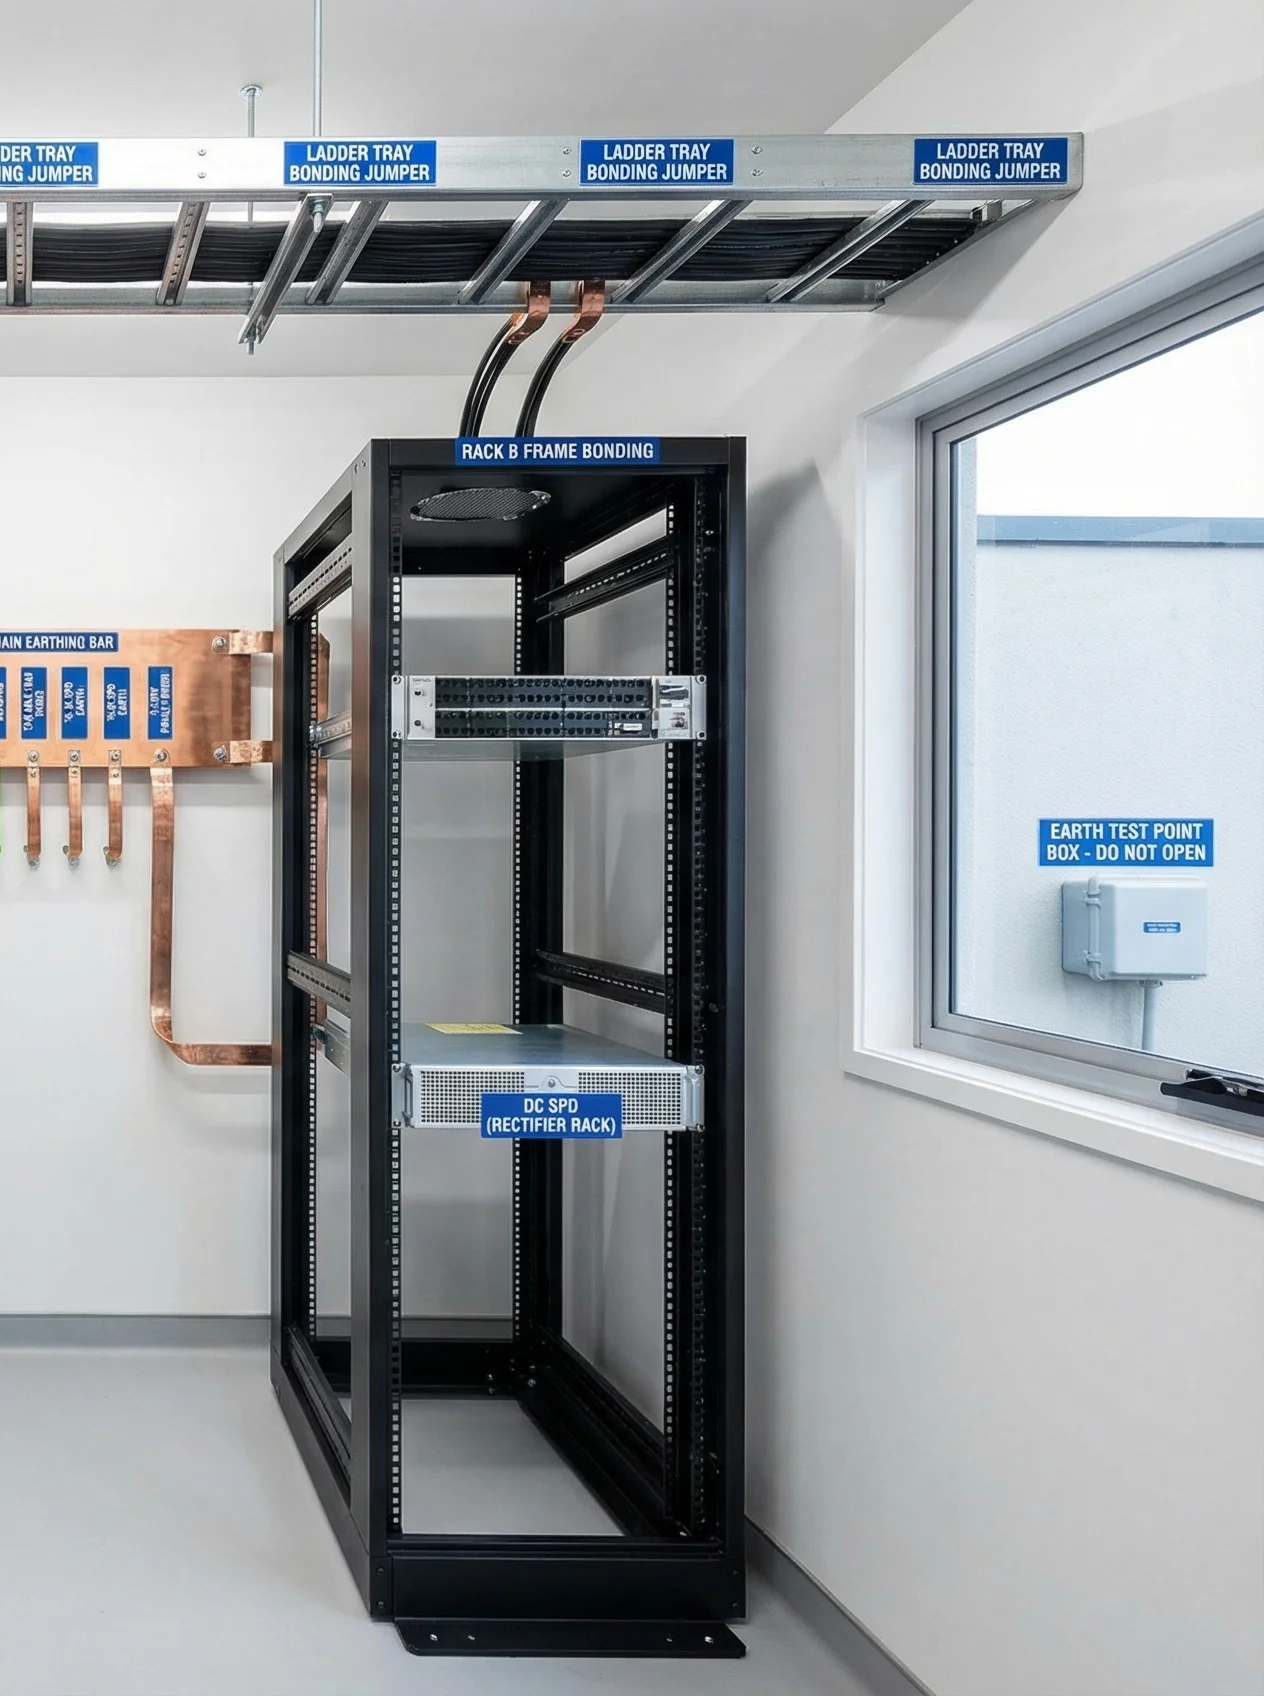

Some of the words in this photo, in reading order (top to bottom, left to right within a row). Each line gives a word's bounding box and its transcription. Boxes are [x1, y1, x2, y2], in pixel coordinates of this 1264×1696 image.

[35, 144, 77, 163] TRAY
[306, 144, 369, 162] LADDER
[372, 144, 414, 162] TRAY
[603, 143, 666, 161] LADDER
[669, 143, 711, 161] TRAY
[937, 142, 999, 160] LADDER
[1003, 142, 1044, 160] TRAY
[27, 164, 93, 183] JUMPER
[289, 164, 361, 182] BONDING
[364, 164, 430, 182] JUMPER
[587, 163, 658, 181] BONDING
[661, 163, 727, 181] JUMPER
[920, 162, 991, 180] BONDING
[994, 162, 1061, 180] JUMPER
[462, 443, 504, 460] RACK
[508, 443, 519, 460] B
[523, 443, 578, 459] FRAME
[582, 442, 654, 459] BONDING
[89, 635, 114, 650] BAR
[1050, 822, 1104, 840] EARTH
[1108, 822, 1149, 840] TEST
[1153, 822, 1204, 840] POINT
[1046, 843, 1080, 861] BOX
[1096, 843, 1119, 861] DO
[1124, 843, 1158, 861] NOT
[1162, 843, 1206, 861] OPEN
[524, 1097, 544, 1114] DC
[548, 1097, 579, 1114] SPD
[486, 1116, 567, 1136] (RECTIFIER
[571, 1116, 616, 1136] RACK)
